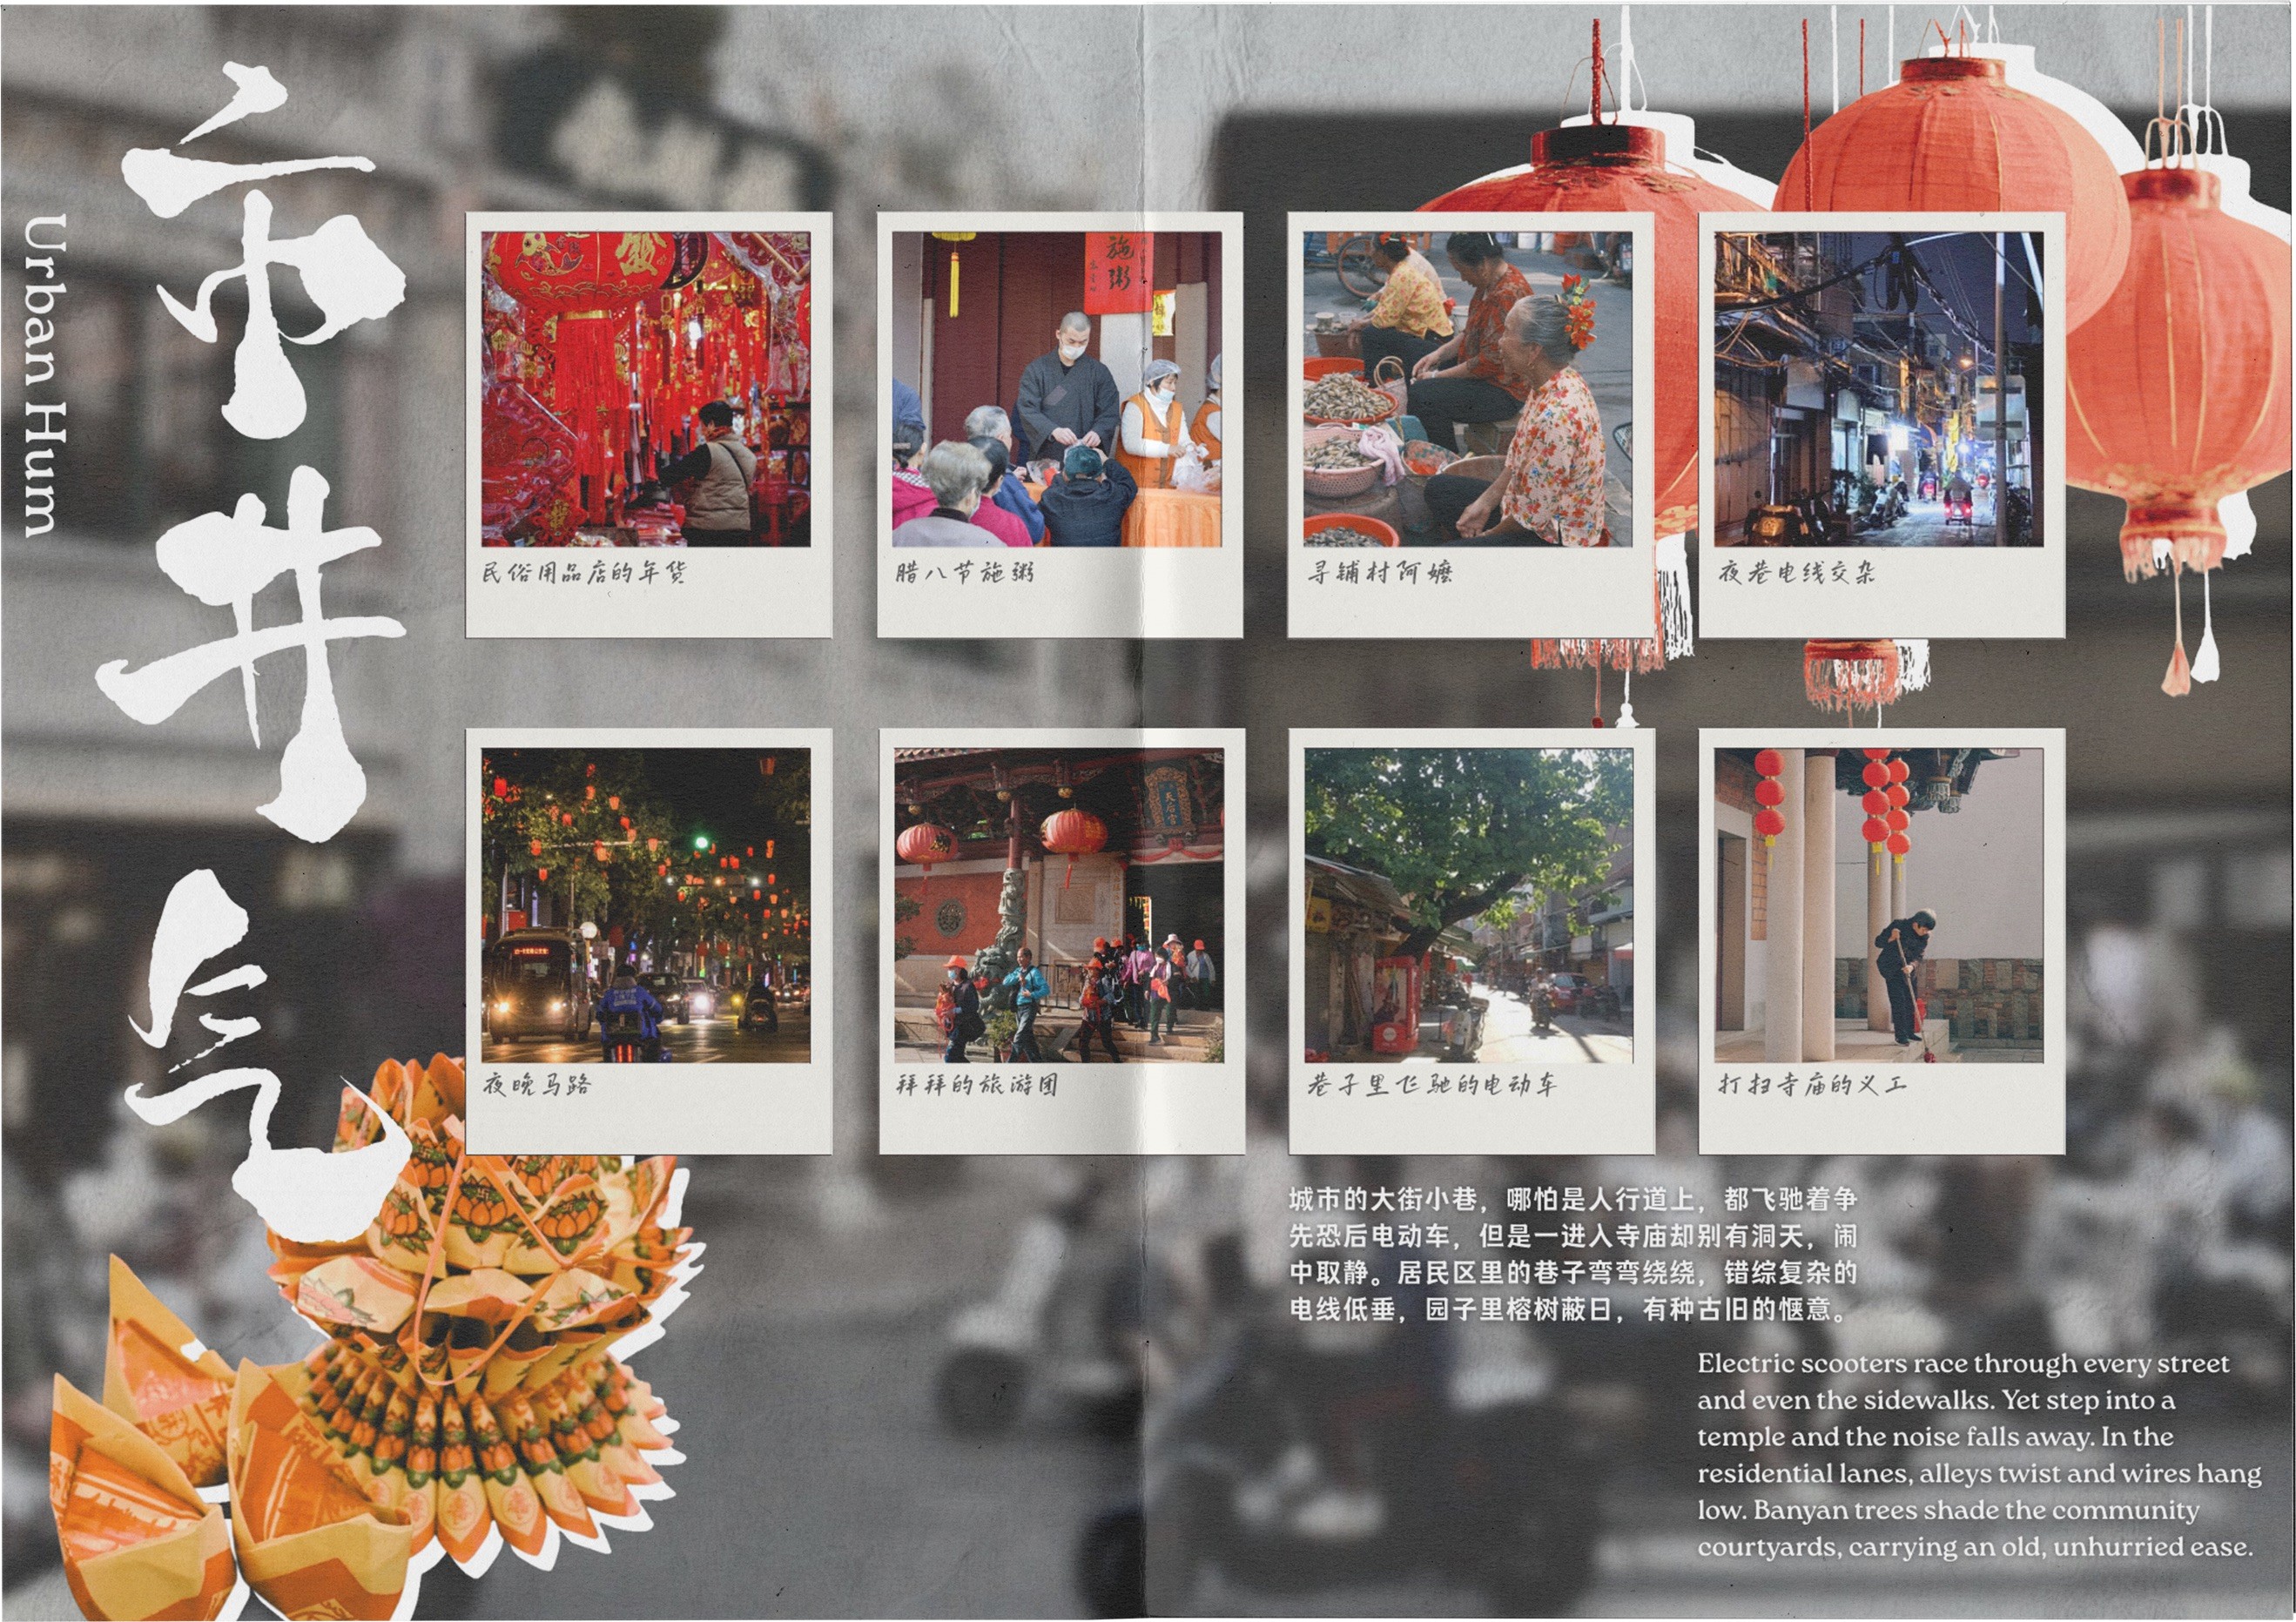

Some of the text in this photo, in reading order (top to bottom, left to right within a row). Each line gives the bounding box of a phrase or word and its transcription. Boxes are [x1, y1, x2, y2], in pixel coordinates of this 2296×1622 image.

[1106, 234, 1135, 291] 施粥
[482, 560, 688, 585] 民俗用品店的年货
[896, 560, 1034, 585] 腊八节施粥
[1719, 560, 1875, 585] 夜巷电线交杂
[483, 1072, 591, 1098] 夜晚马路
[896, 1072, 1058, 1097] 拜拜的旅游团
[1308, 1072, 1558, 1097] 巷子里飞驰的电动车
[1718, 1072, 1908, 1097] 打扫寺庙的义工
